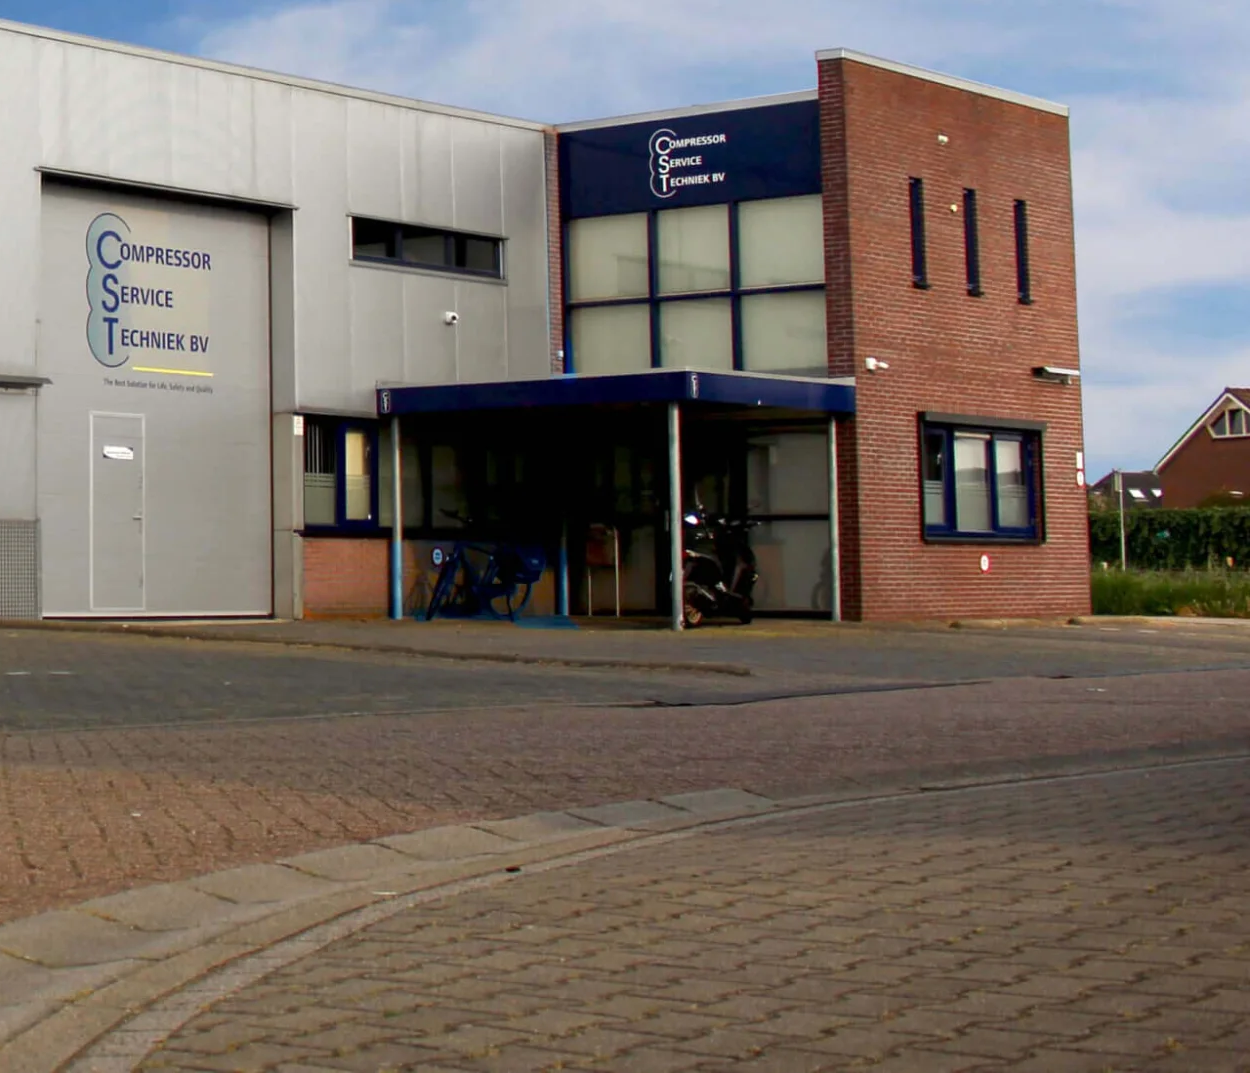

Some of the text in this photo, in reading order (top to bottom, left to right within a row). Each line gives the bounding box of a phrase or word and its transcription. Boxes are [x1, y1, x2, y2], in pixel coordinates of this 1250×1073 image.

[655, 134, 727, 155] COMPRESSOR
[658, 155, 703, 174] SERVICE
[659, 172, 726, 192] TECHNIEK BV
[96, 230, 212, 270] COMPRESSOR
[101, 273, 174, 313] SERVICE
[102, 316, 209, 355] TECHNIEK BV
